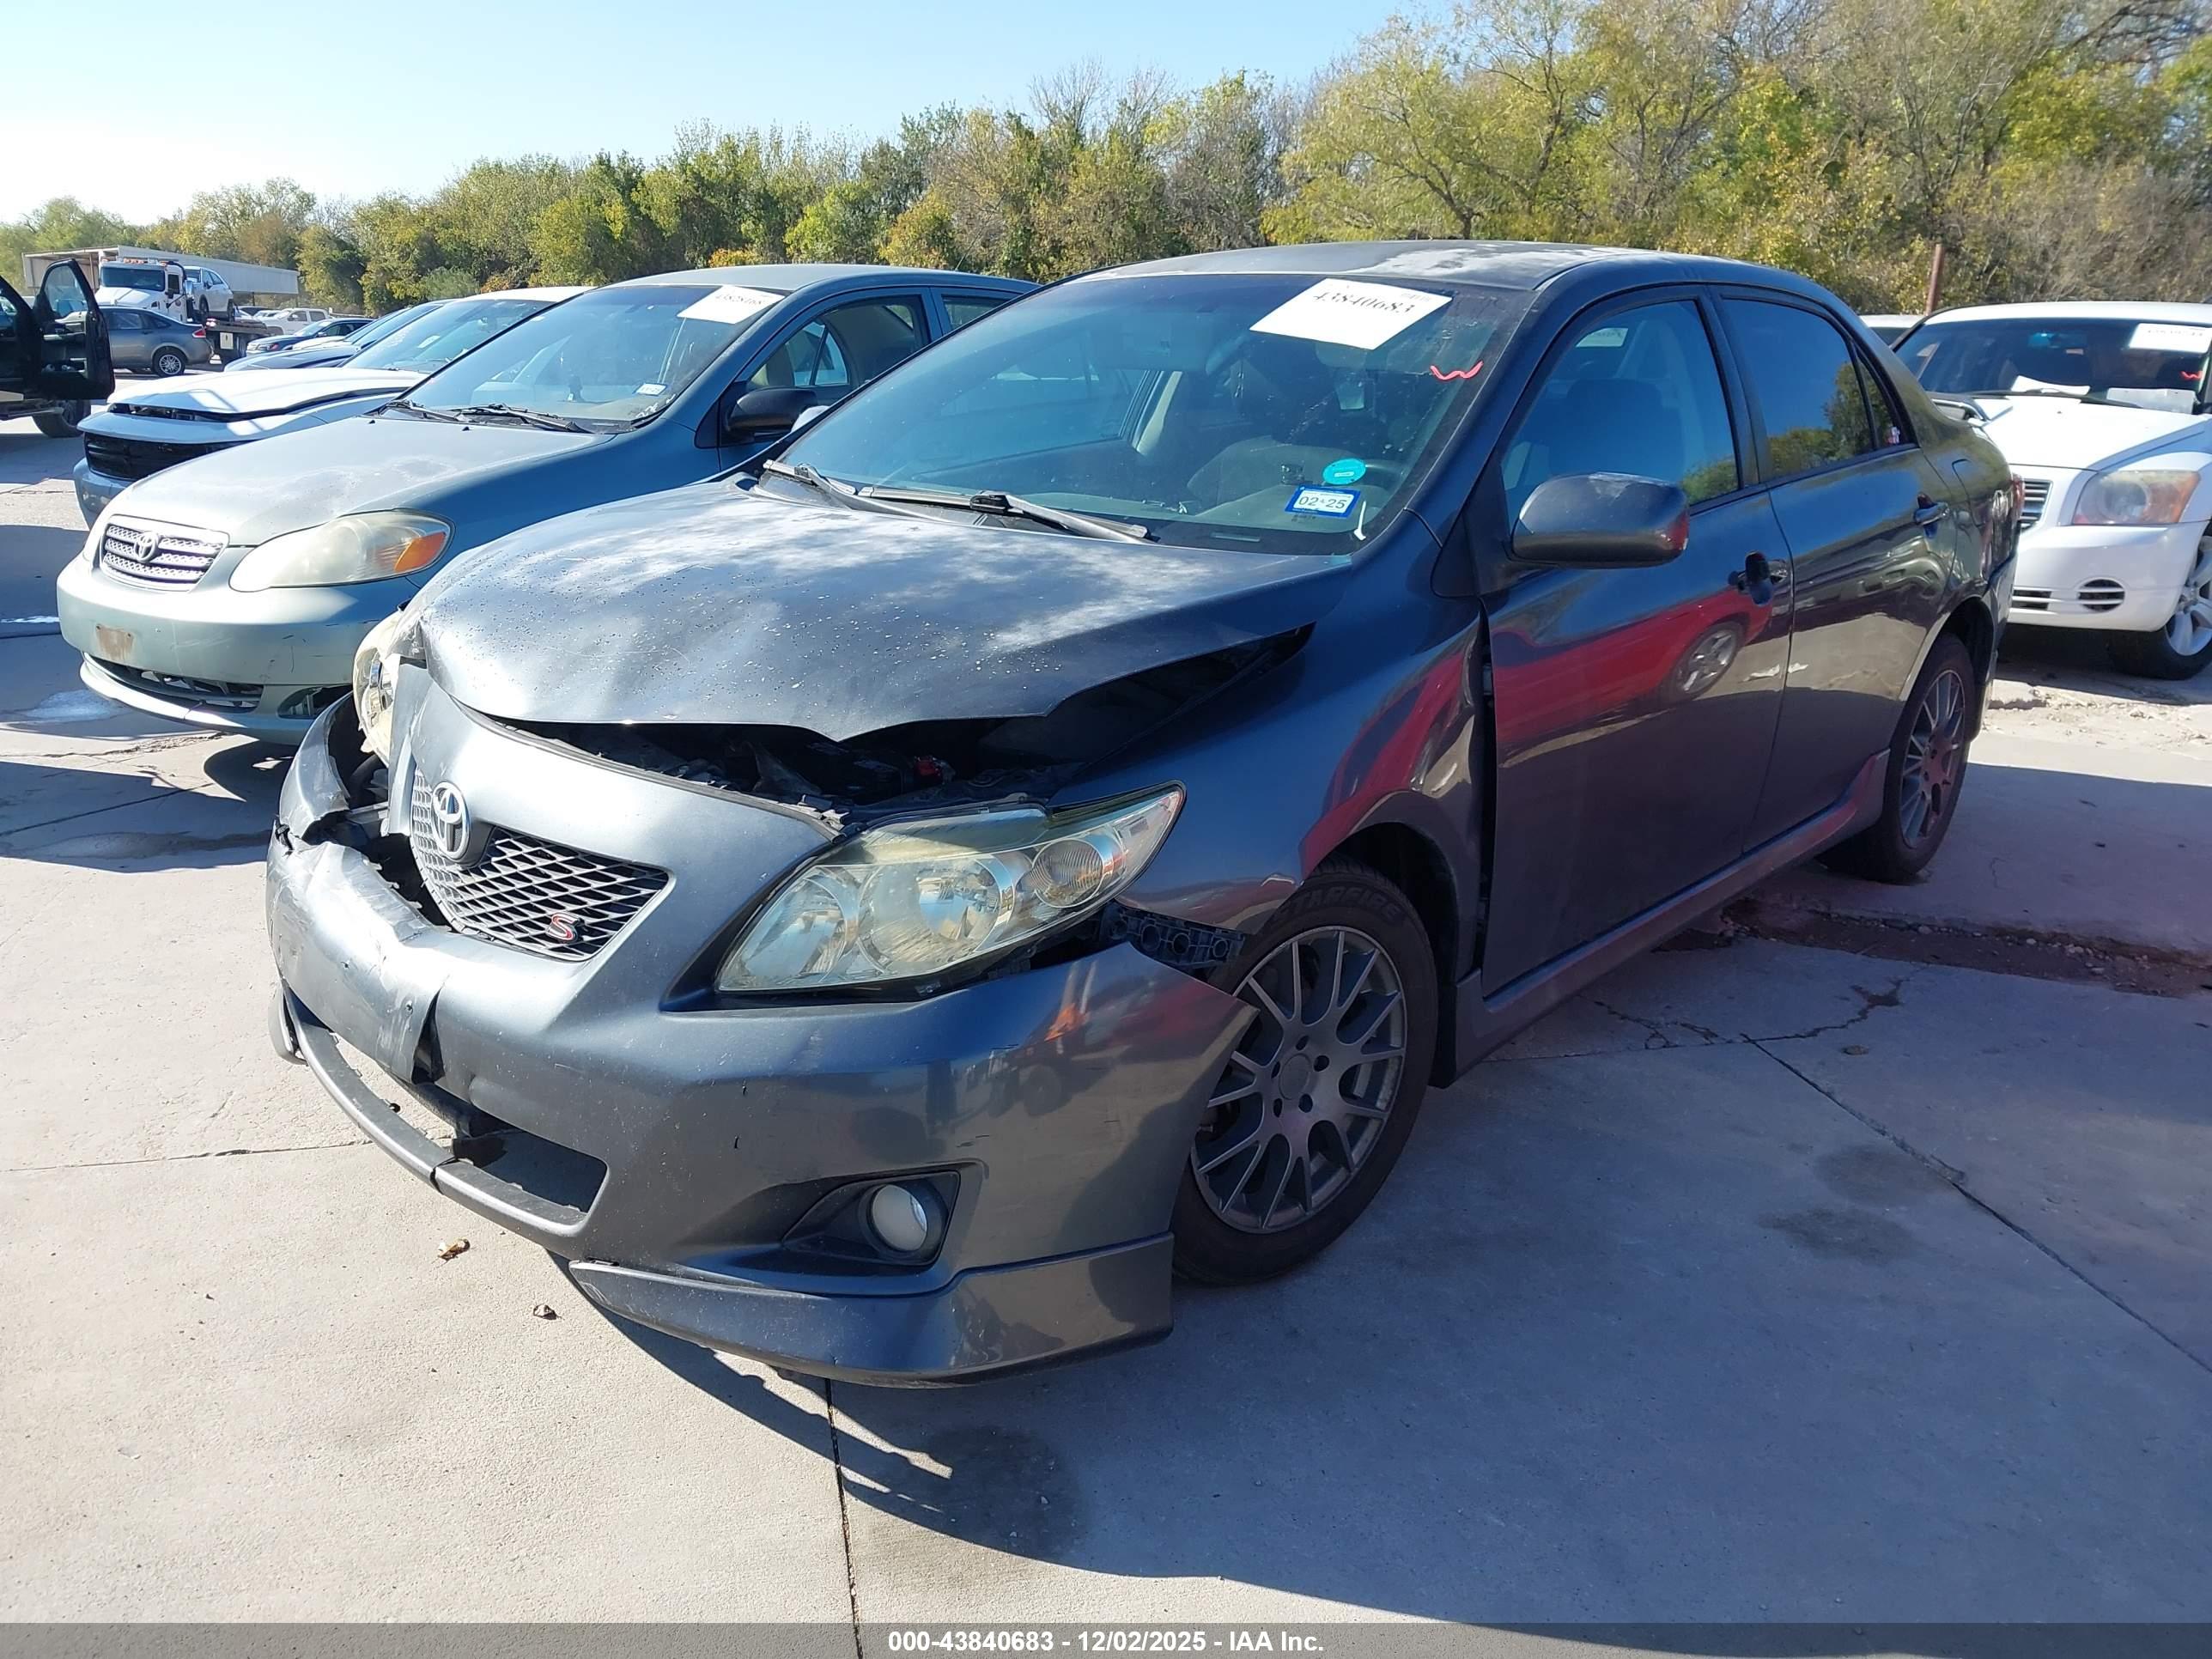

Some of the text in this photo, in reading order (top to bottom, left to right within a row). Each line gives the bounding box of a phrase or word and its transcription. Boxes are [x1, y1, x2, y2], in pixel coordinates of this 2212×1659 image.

[1298, 496, 1347, 509] 02 25
[547, 911, 579, 944] S
